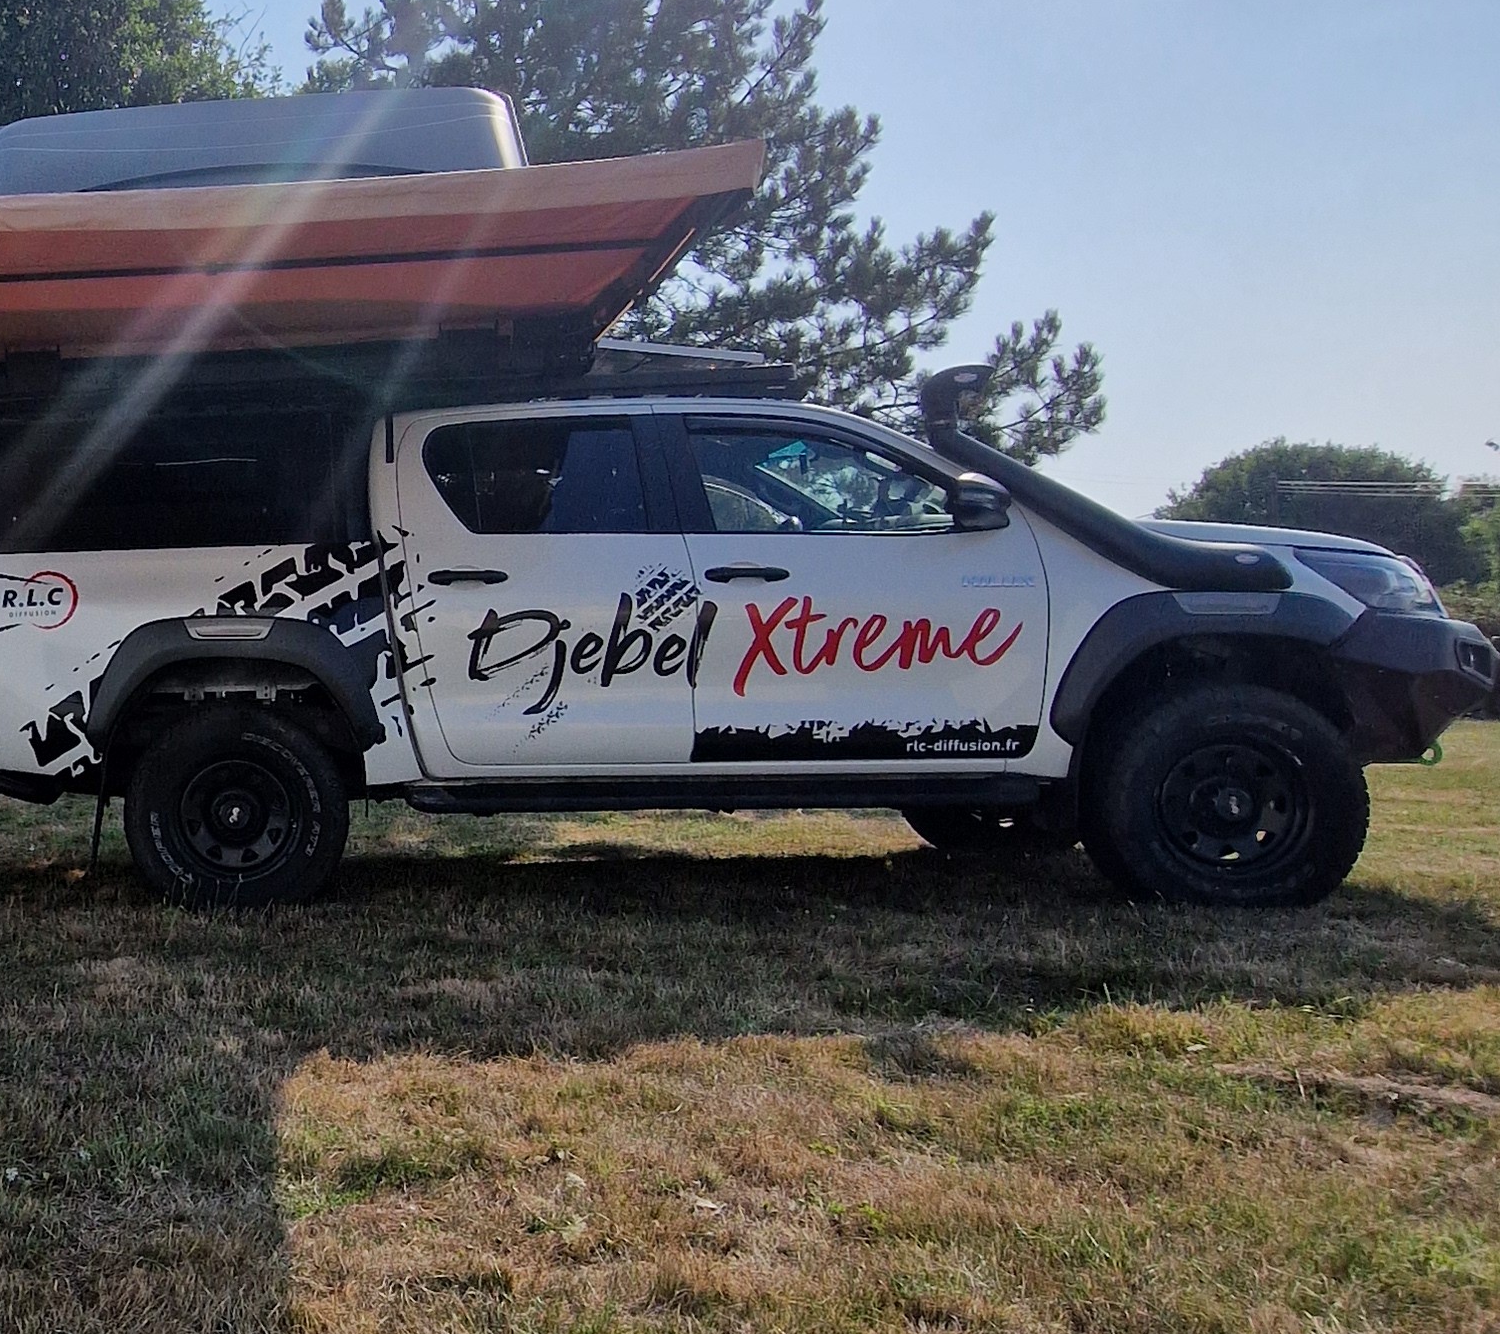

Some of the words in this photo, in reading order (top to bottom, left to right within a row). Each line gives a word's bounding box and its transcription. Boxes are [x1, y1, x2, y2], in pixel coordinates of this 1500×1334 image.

[2, 587, 64, 608] R.L.C
[8, 610, 57, 618] DIFFUSION
[467, 592, 718, 715] Djebel
[732, 595, 1024, 698] Xtreme
[906, 738, 1020, 752] rlc-diffusion.fr
